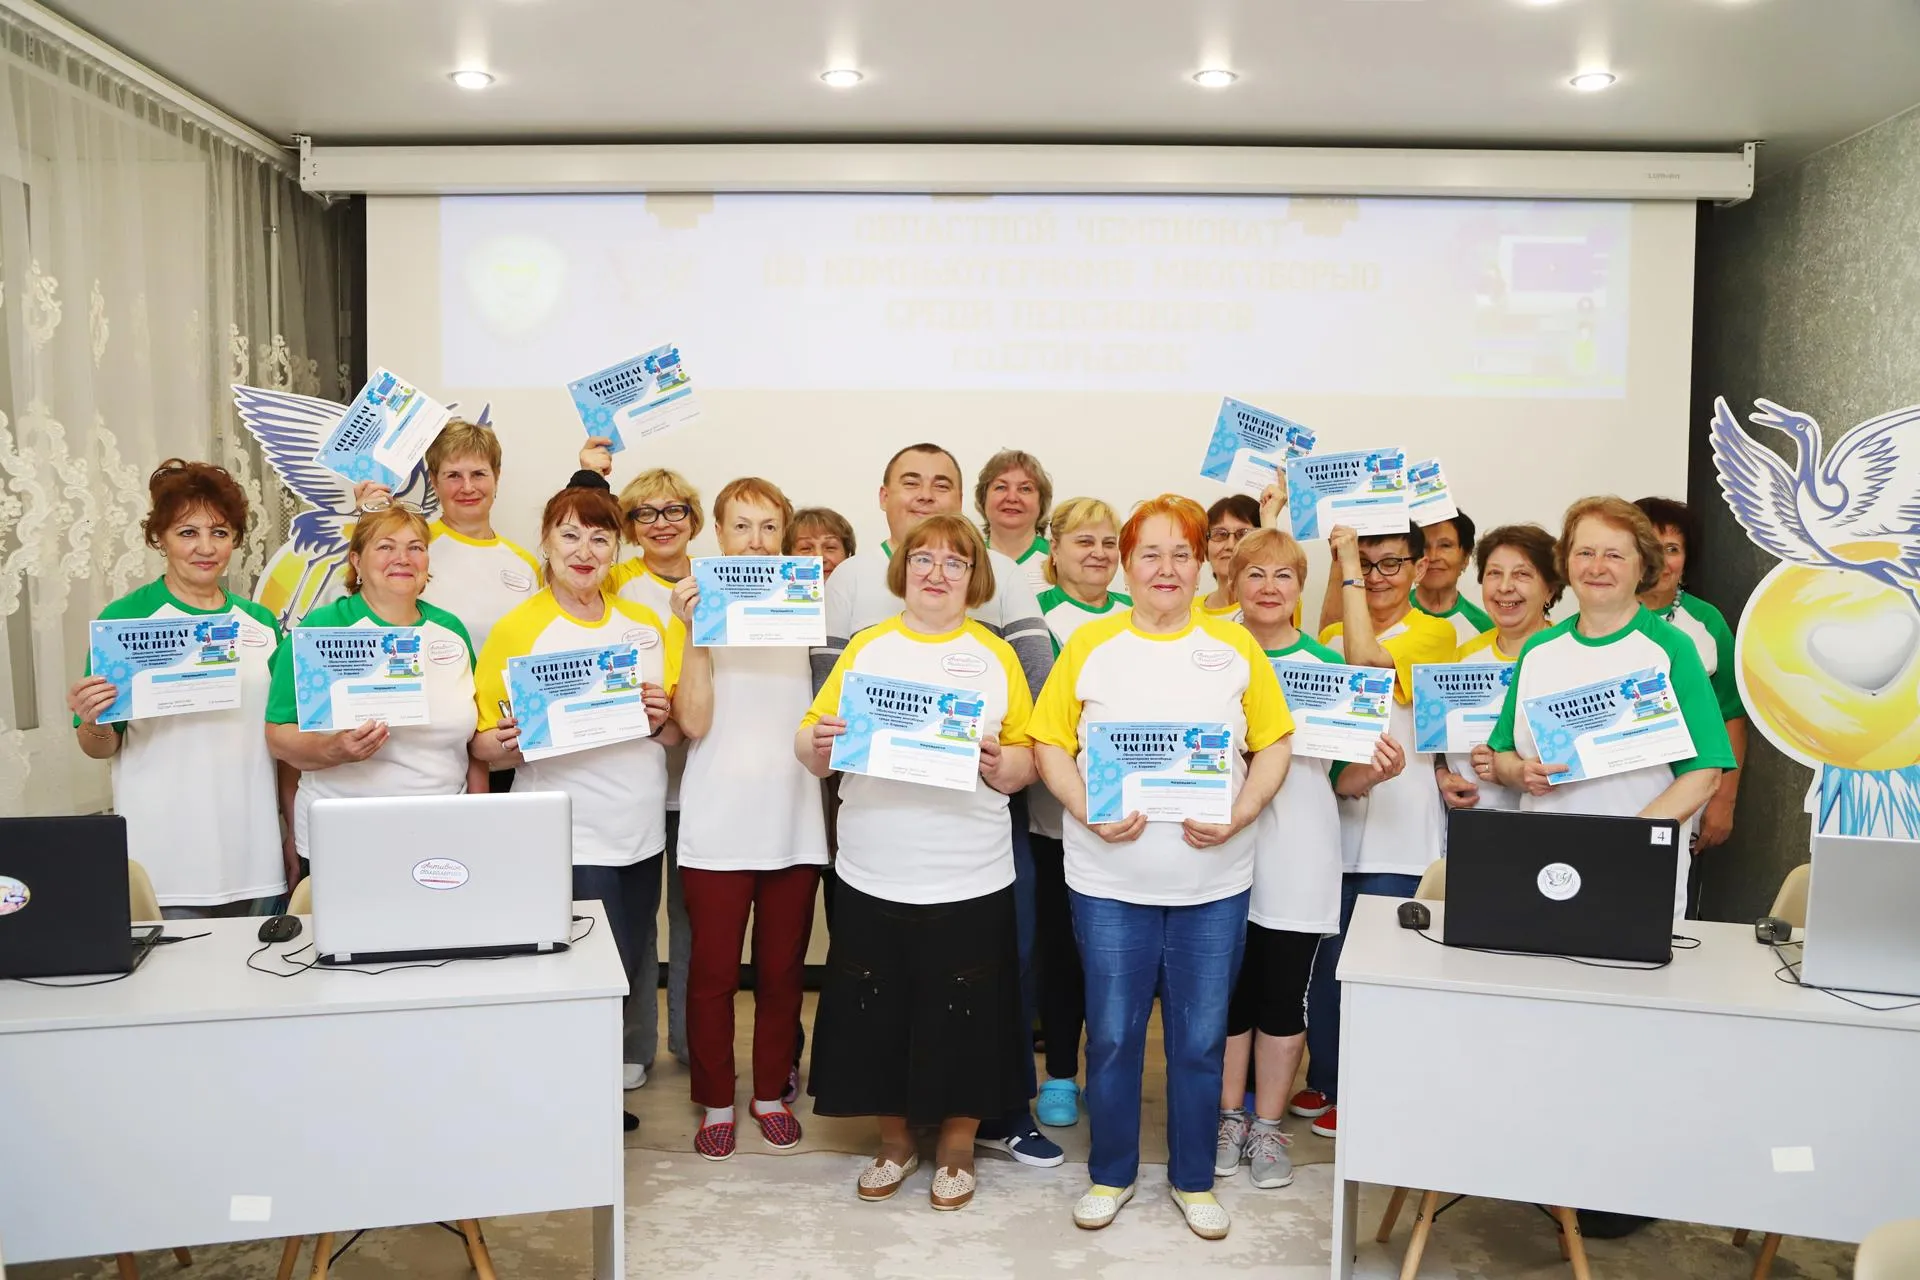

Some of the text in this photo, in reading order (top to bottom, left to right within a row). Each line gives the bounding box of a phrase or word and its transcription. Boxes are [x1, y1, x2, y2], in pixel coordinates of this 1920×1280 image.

[118, 629, 188, 641] СЕРТИФИКАТ
[123, 639, 185, 650] УЧАСТНИКА
[1111, 733, 1177, 742] СЕРТИФИКАТ
[1115, 744, 1174, 752] УЧАСТНИКА
[1657, 831, 1665, 841] 4
